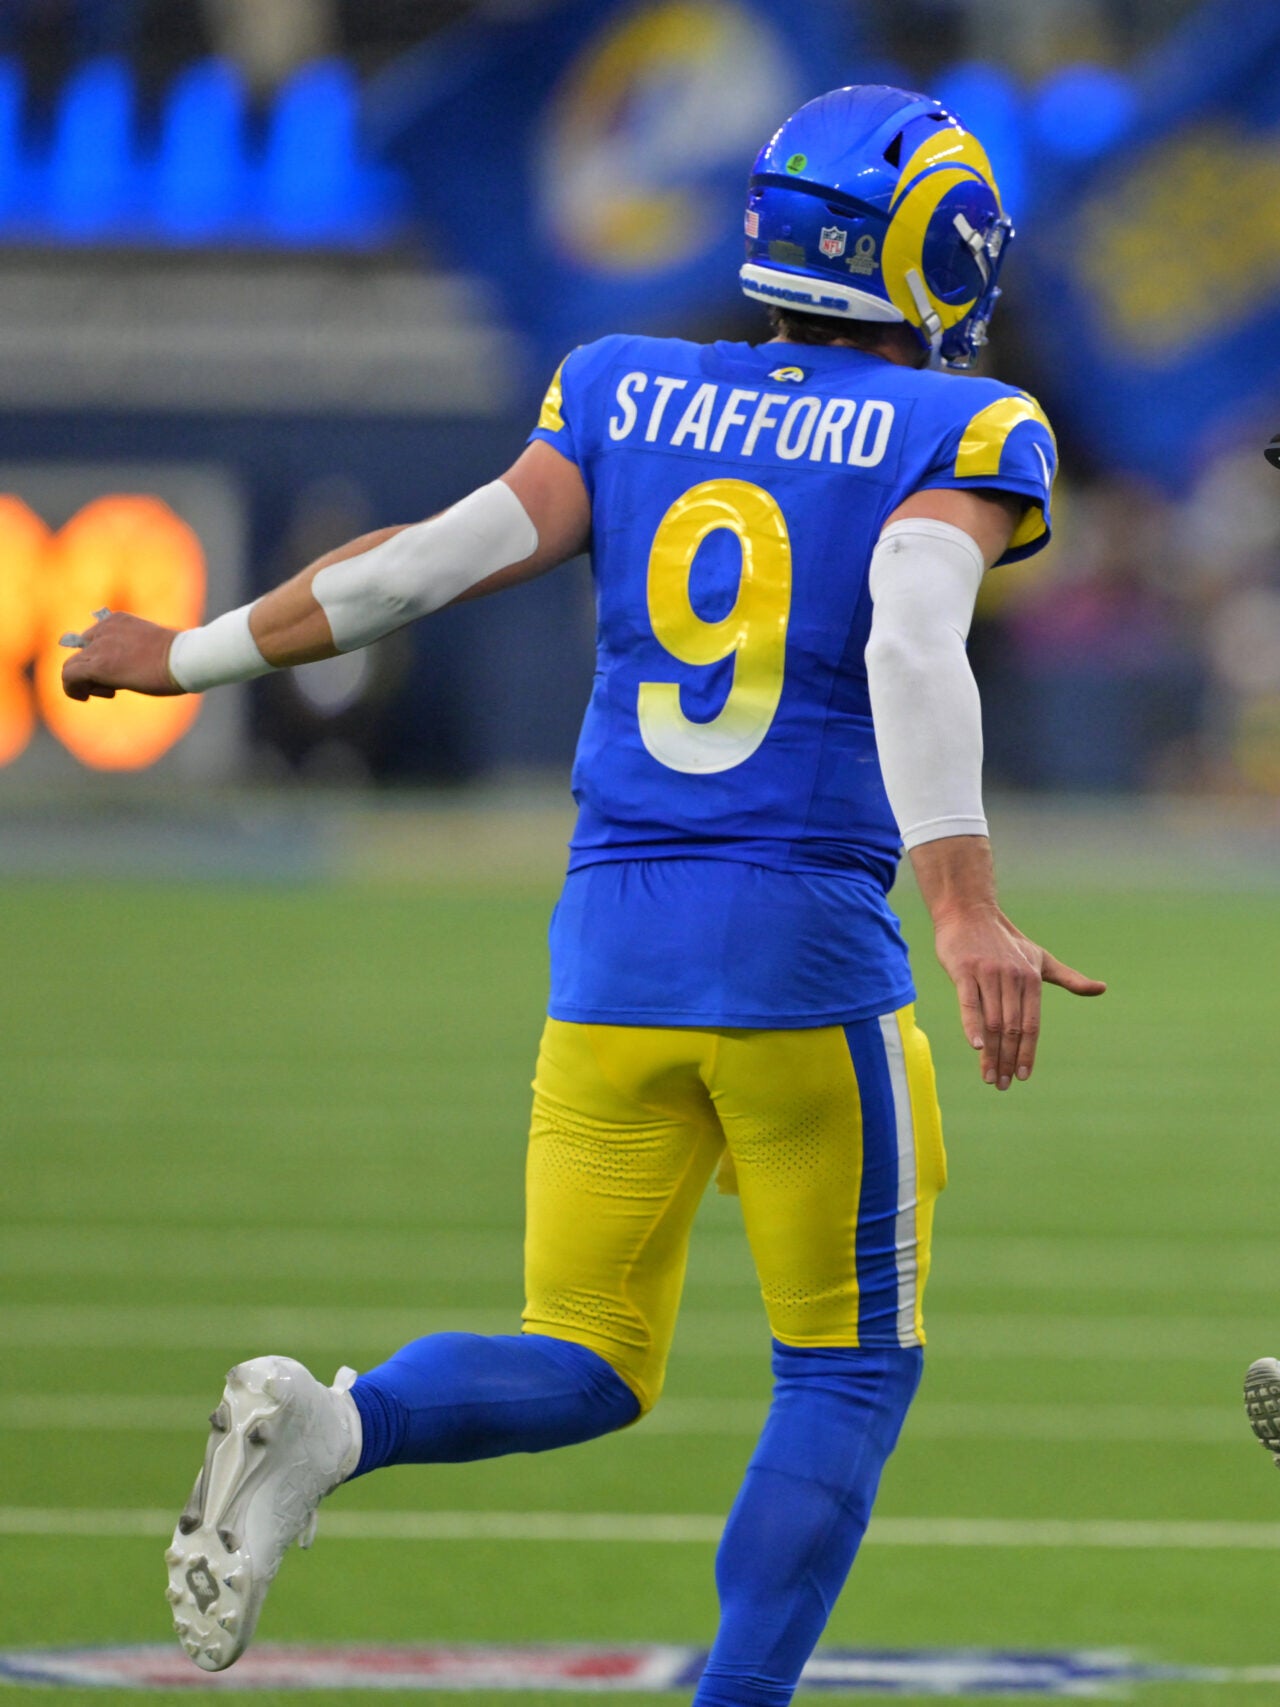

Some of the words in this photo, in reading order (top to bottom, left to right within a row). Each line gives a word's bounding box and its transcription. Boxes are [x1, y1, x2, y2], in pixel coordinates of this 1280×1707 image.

[823, 239, 842, 253] NFL
[609, 371, 895, 468] STAFFORD
[637, 478, 792, 775] 9
